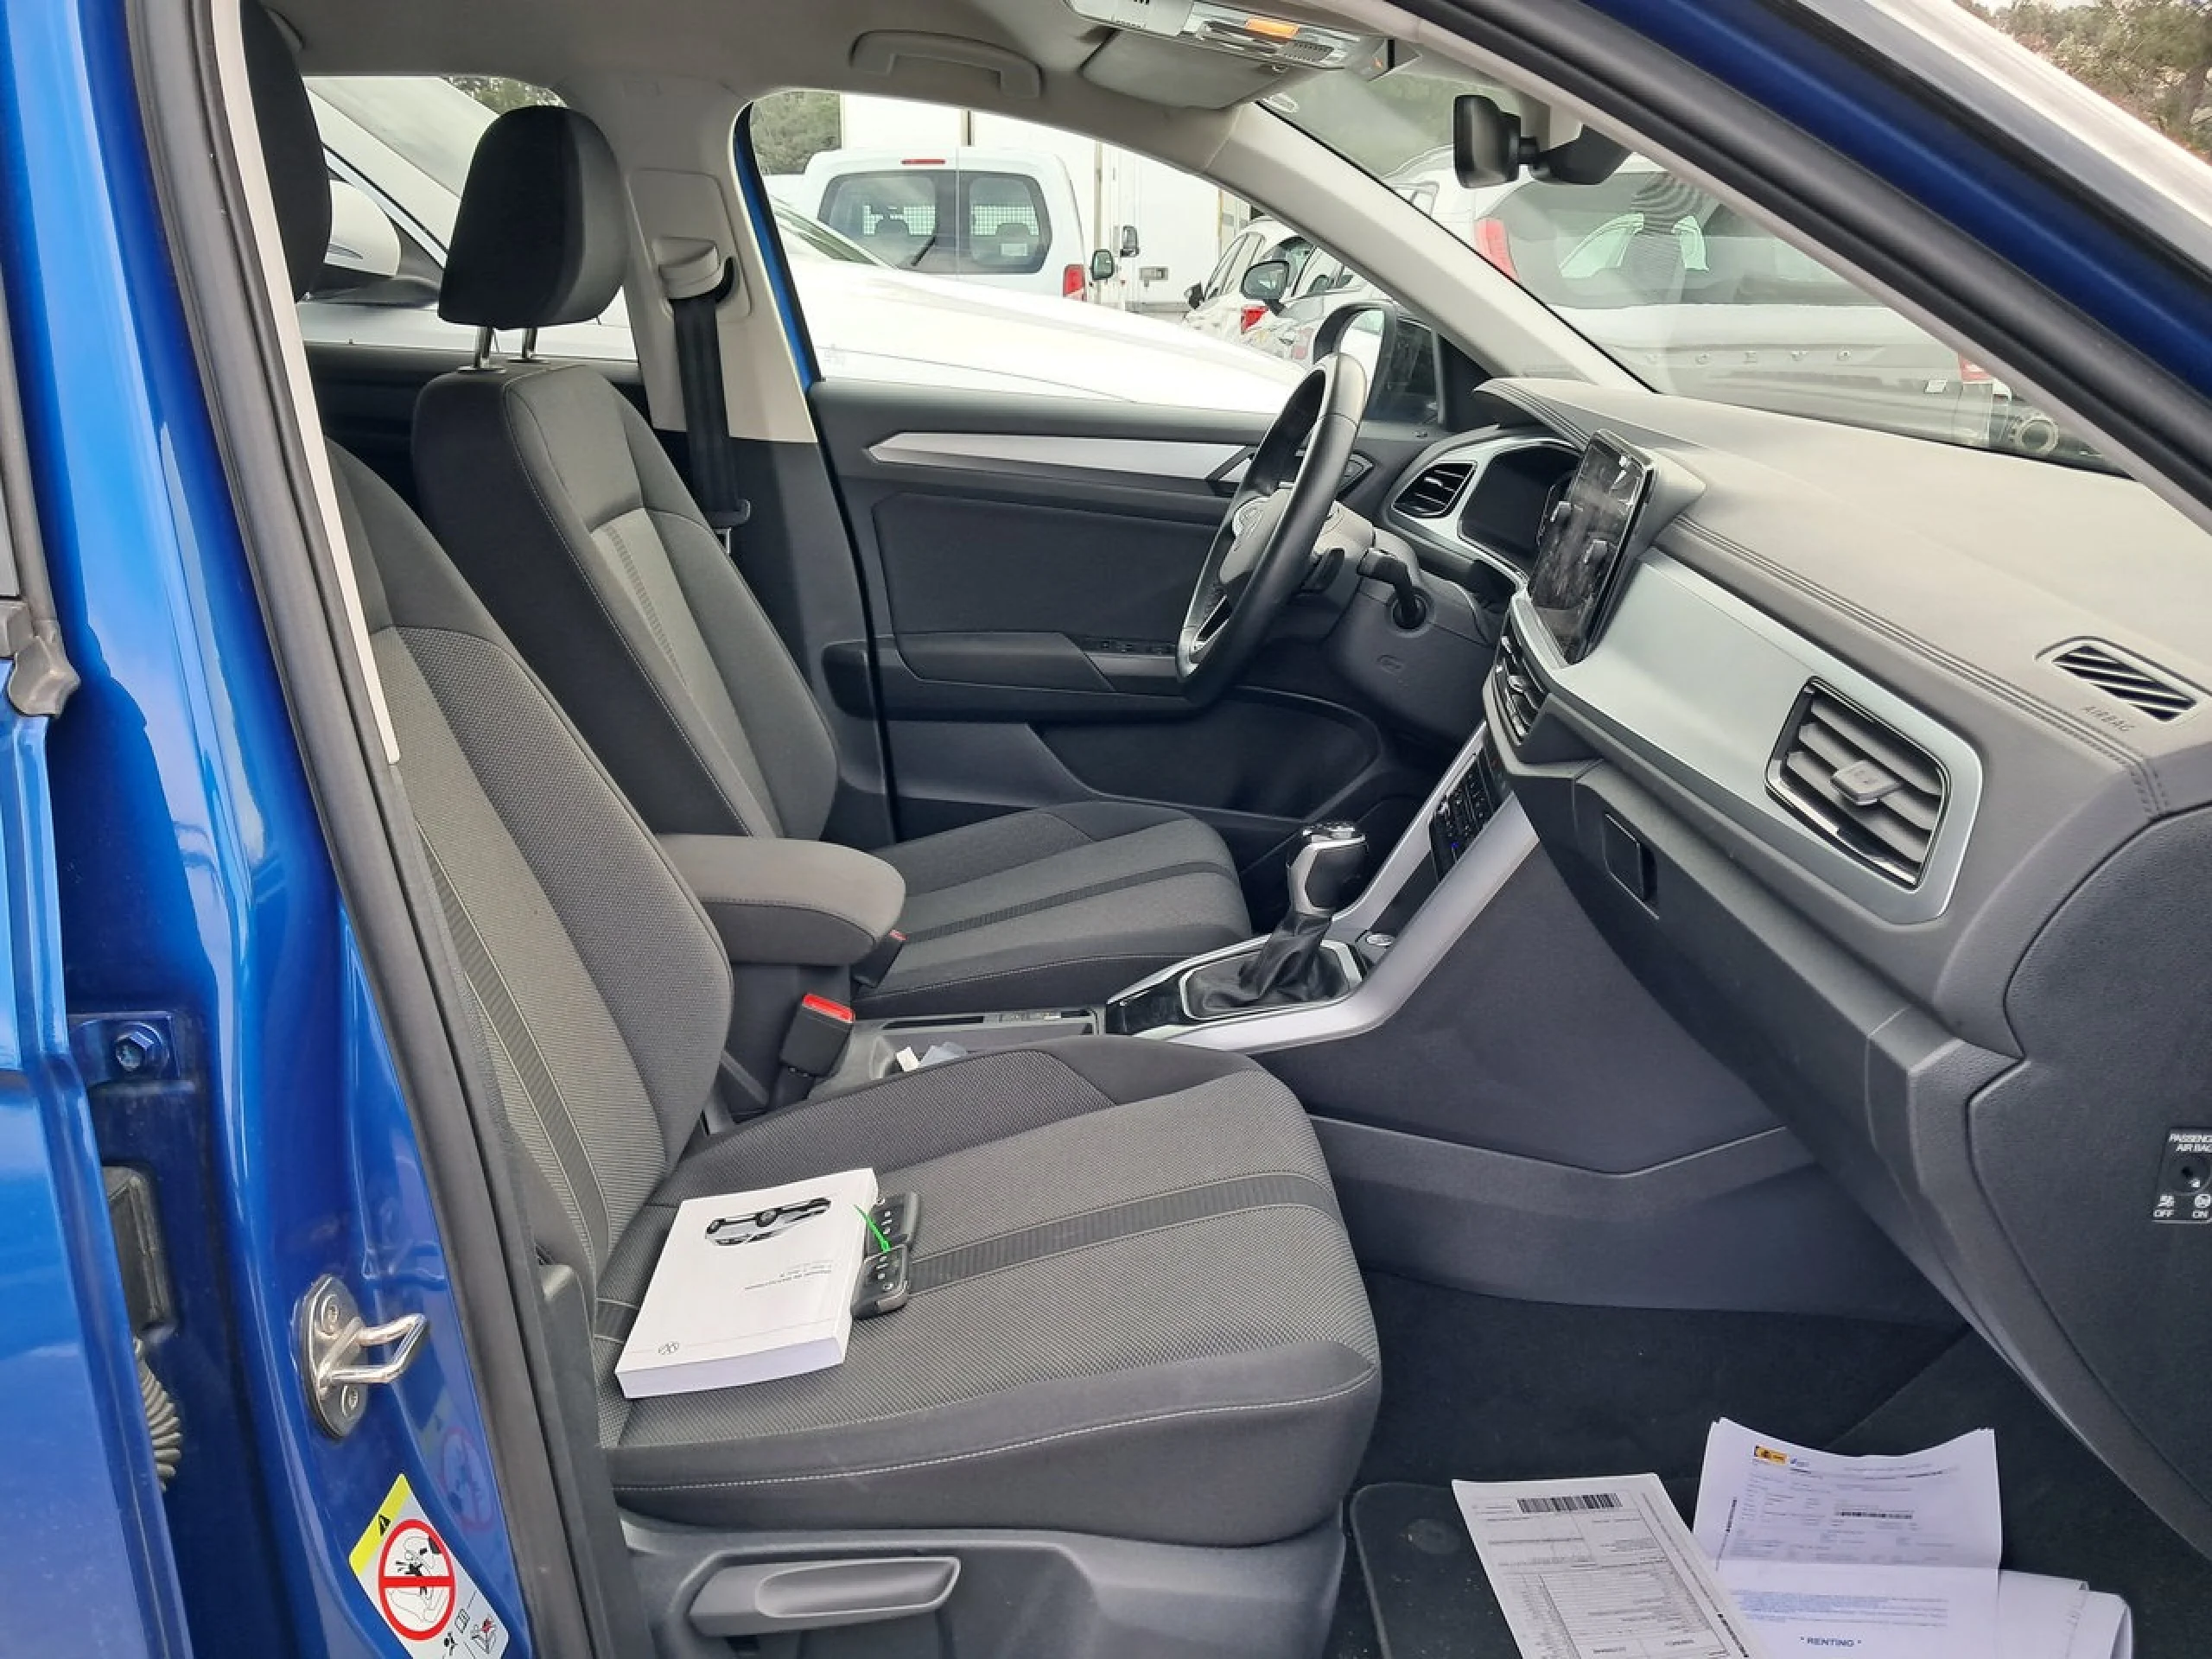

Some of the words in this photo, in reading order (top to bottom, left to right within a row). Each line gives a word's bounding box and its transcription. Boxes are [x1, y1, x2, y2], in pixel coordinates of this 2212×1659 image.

[2153, 1209, 2174, 1217] OFF
[2192, 1210, 2209, 1218] ON
[1807, 1637, 1855, 1647] RENTING
